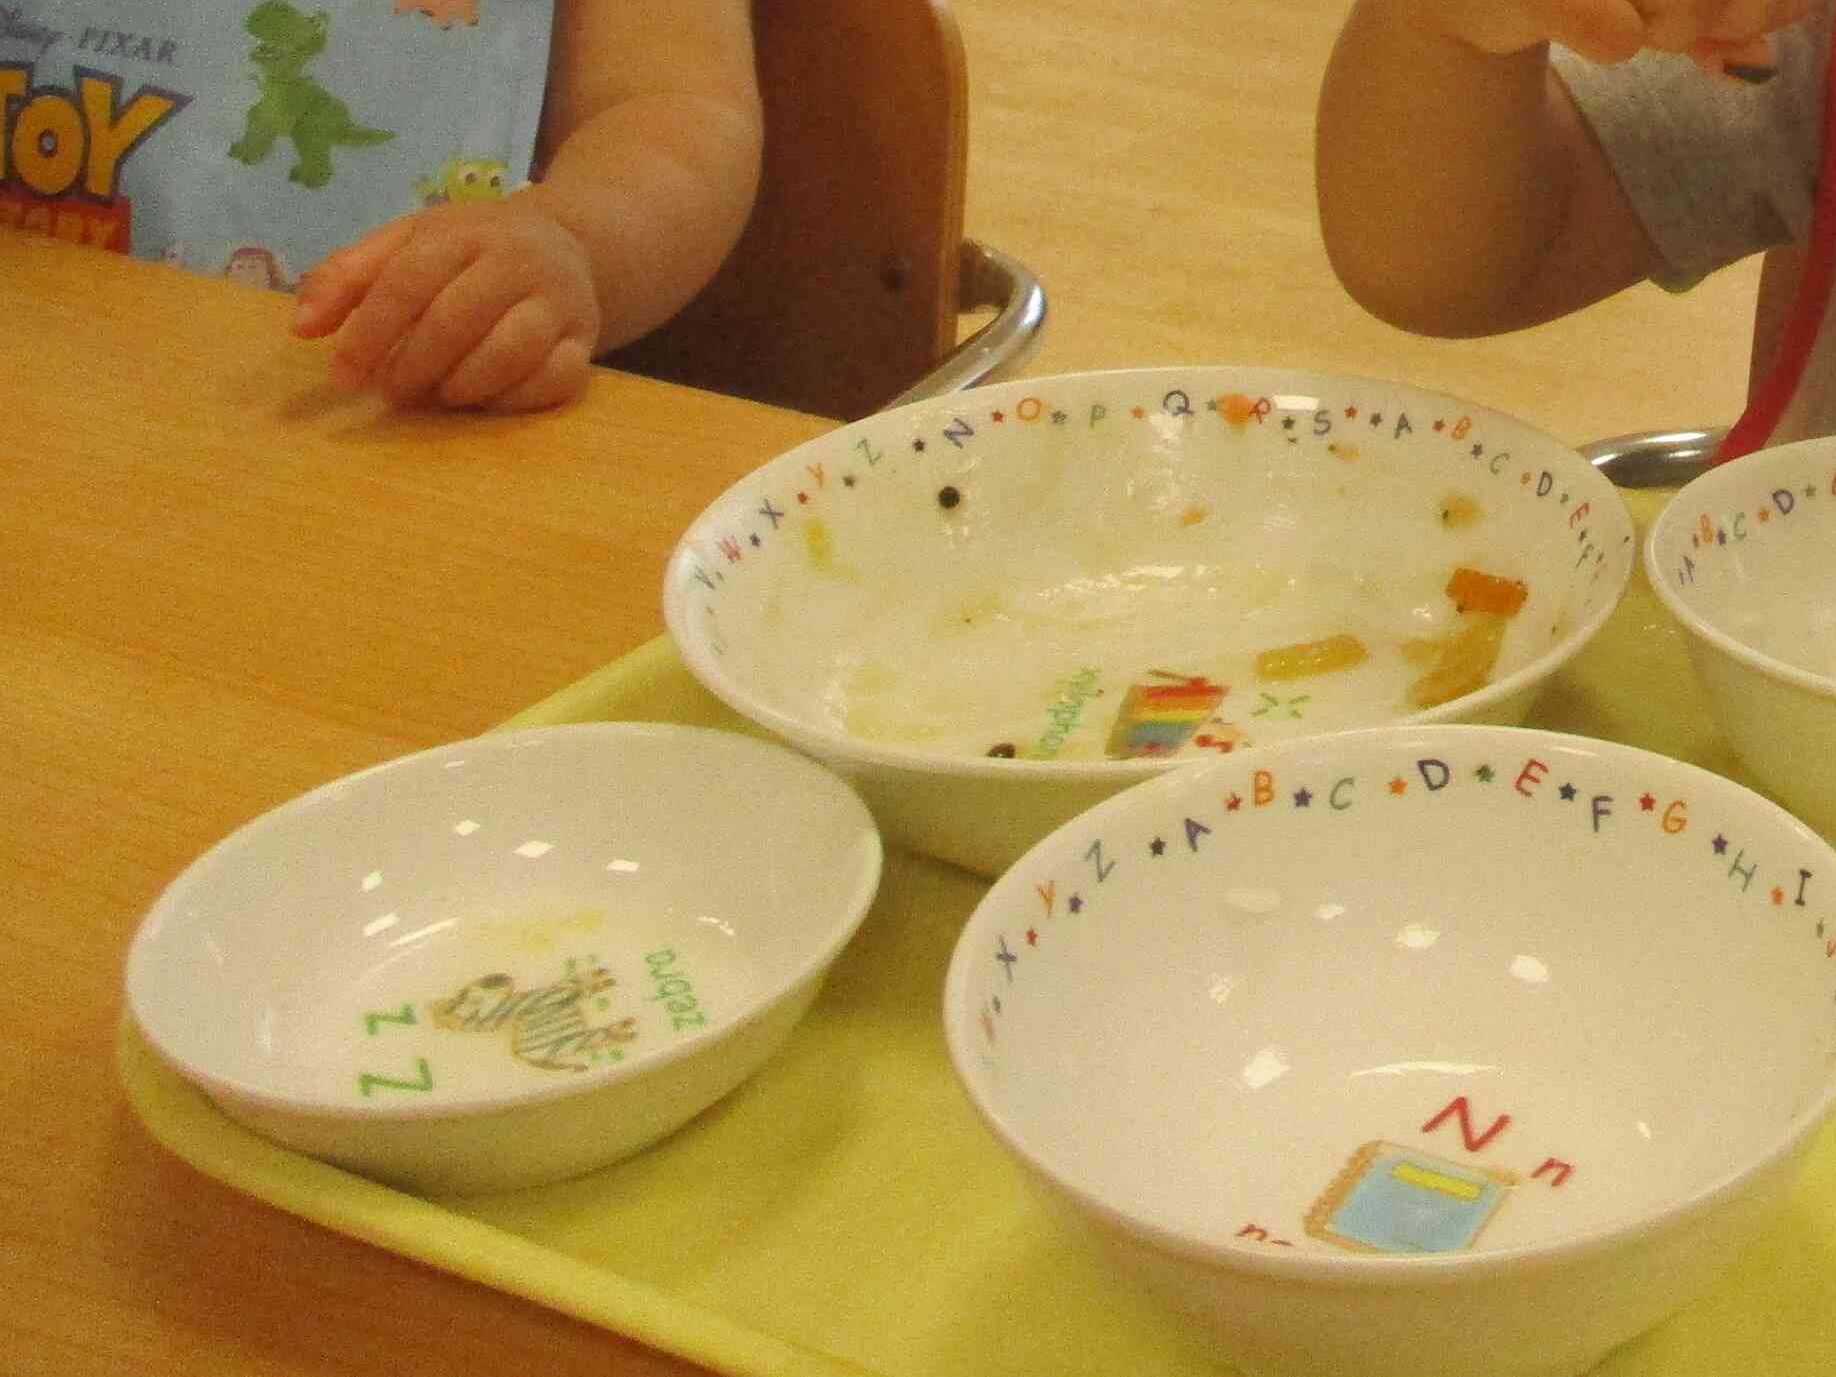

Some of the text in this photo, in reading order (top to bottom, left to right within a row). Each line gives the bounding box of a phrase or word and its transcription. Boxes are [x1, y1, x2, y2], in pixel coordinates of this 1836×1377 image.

[758, 497, 785, 530] X
[855, 437, 883, 466] Z
[942, 417, 976, 450] N
[1015, 397, 1042, 422] O
[1089, 403, 1108, 431] P
[1162, 389, 1196, 418] Q
[1311, 408, 1333, 436] S
[1393, 412, 1414, 440] A
[1450, 415, 1473, 441] B
[1489, 452, 1511, 474] C
[1535, 470, 1554, 498] D
[1569, 501, 1591, 530] E
[1733, 511, 1748, 542] C
[1771, 488, 1796, 516] D
[995, 934, 1018, 984] X
[1035, 879, 1057, 920] Y
[1084, 838, 1118, 883] Z
[1183, 817, 1212, 853] A
[1252, 768, 1276, 808] B
[1329, 776, 1355, 811] C
[1416, 757, 1451, 792] D
[1514, 758, 1550, 798] E
[1591, 794, 1615, 833] F
[1661, 798, 1689, 835] G
[1727, 848, 1759, 894] H
[1794, 868, 1814, 907] I
[1420, 1095, 1515, 1153] N
